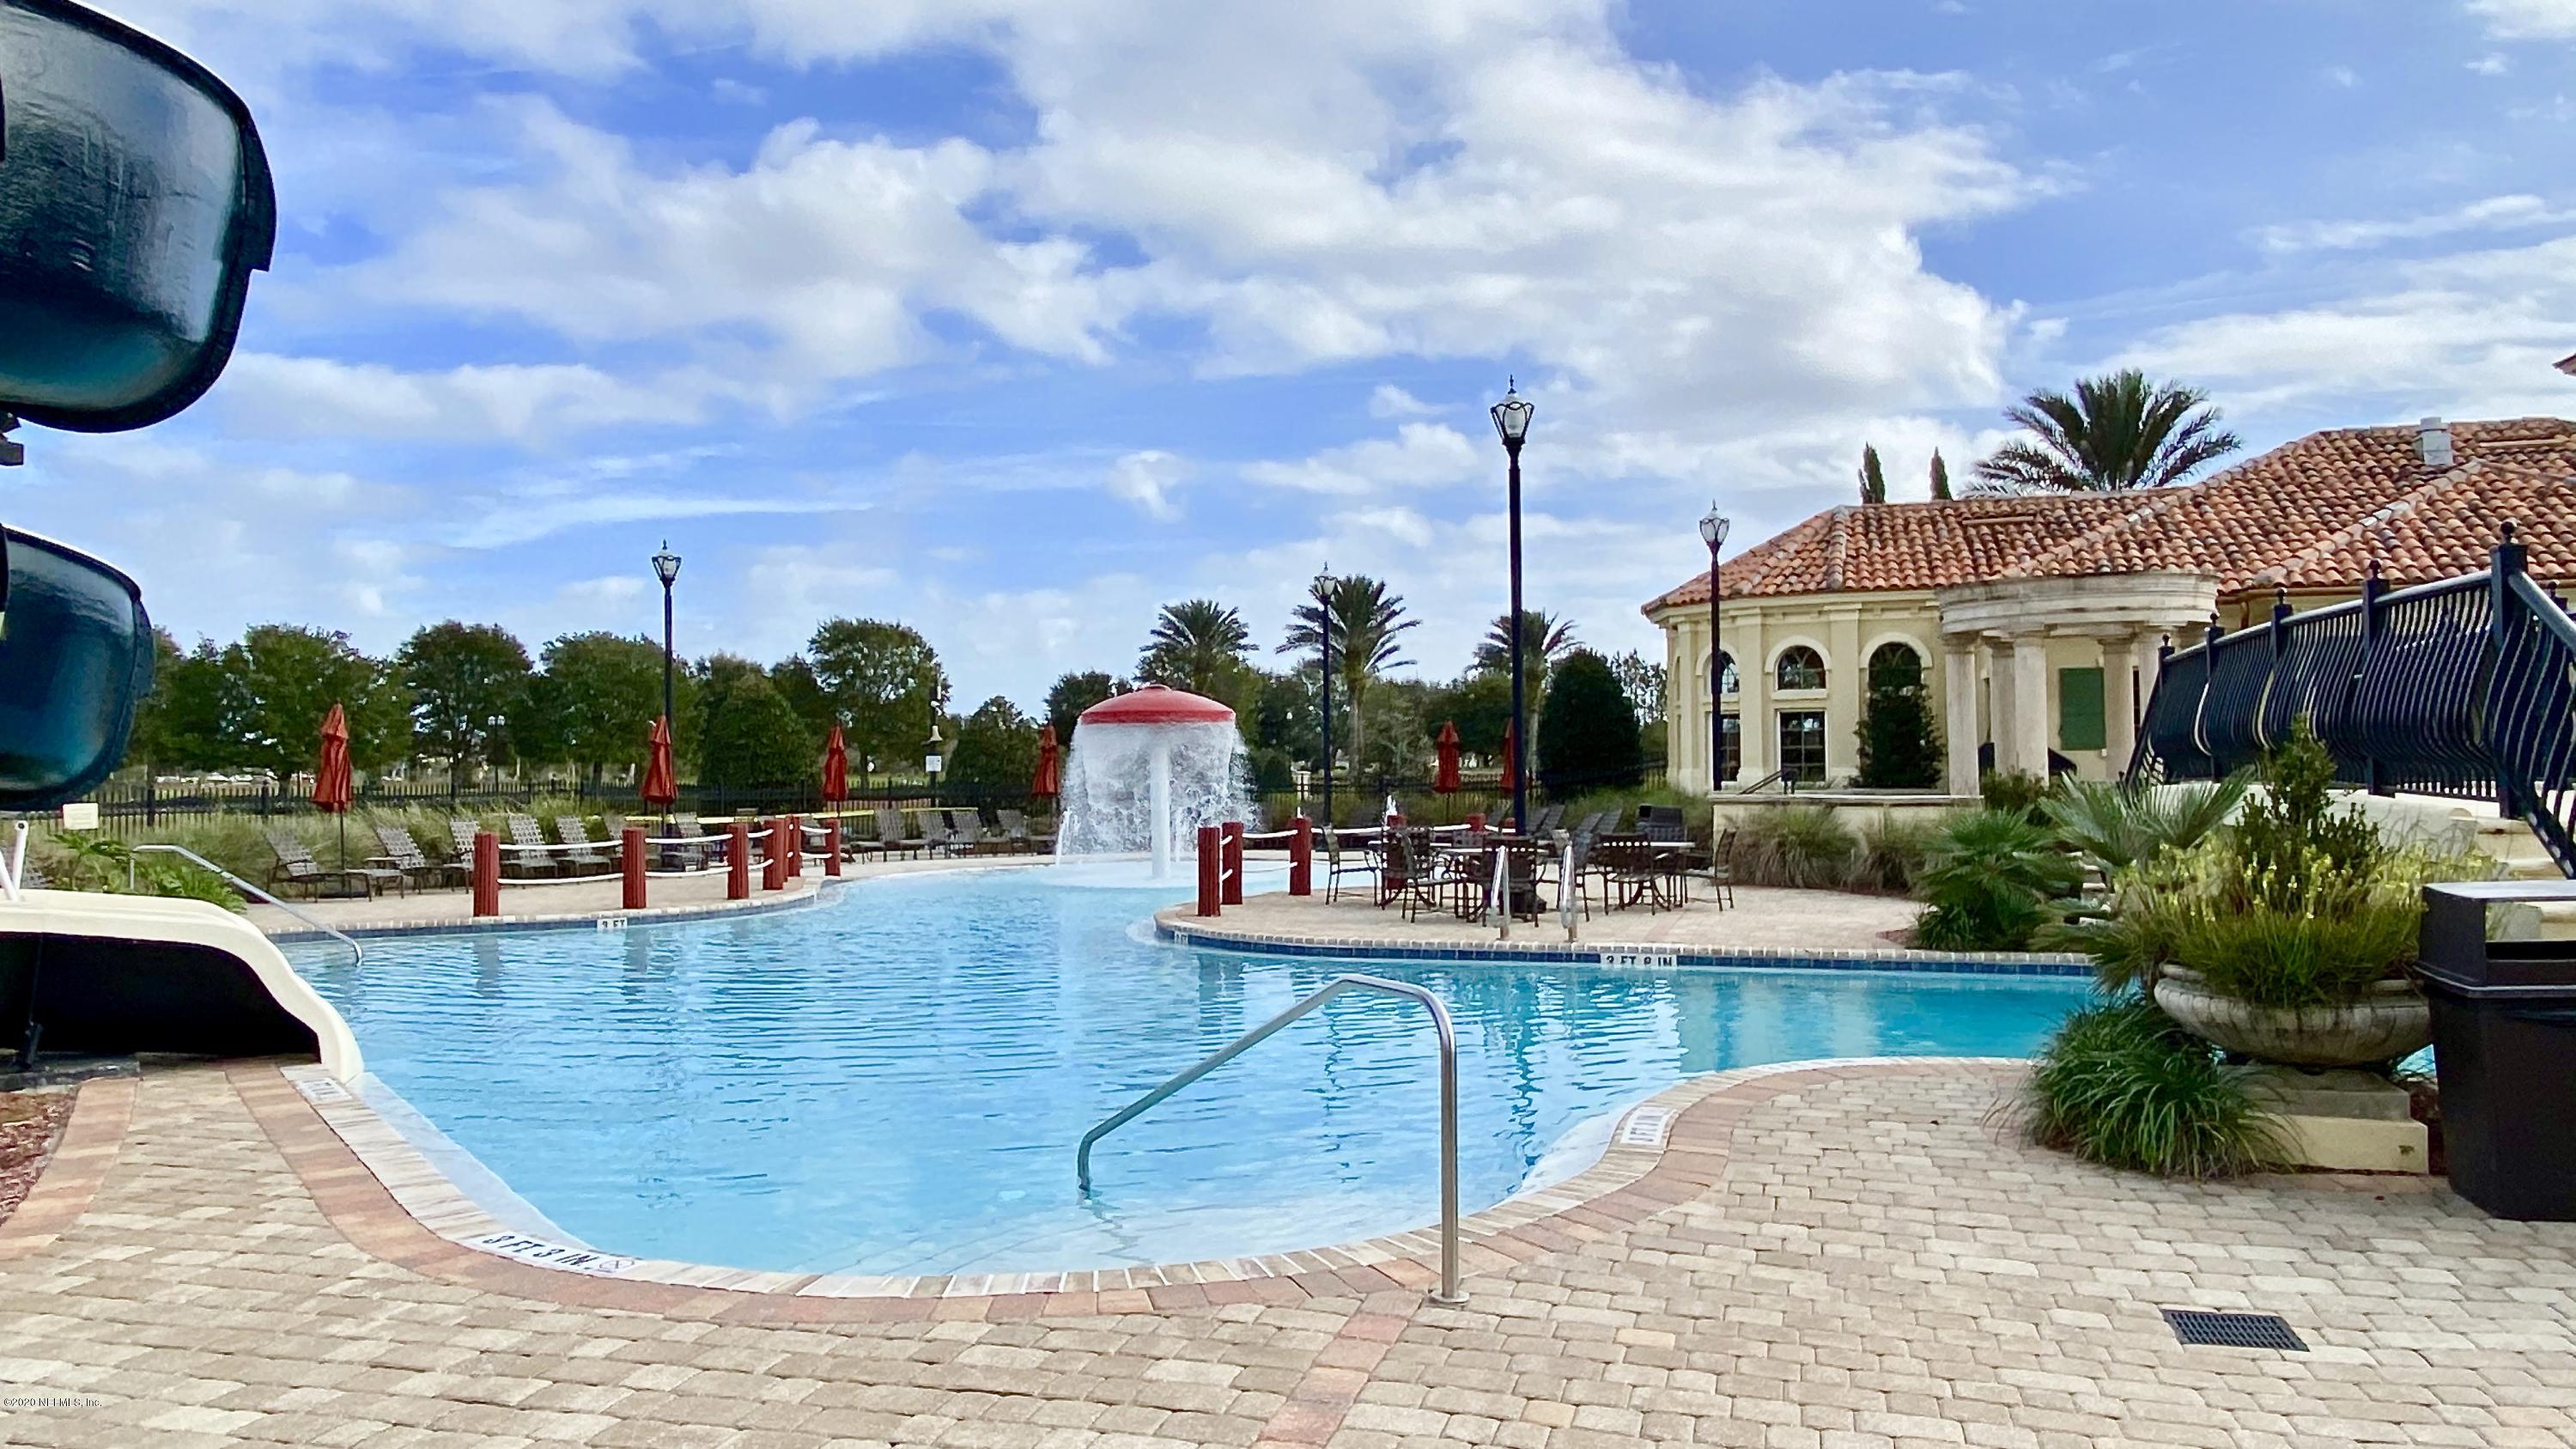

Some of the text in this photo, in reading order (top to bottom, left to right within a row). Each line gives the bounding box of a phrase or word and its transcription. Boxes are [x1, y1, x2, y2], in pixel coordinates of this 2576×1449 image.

[1620, 955, 1637, 965] FT
[1657, 956, 1672, 967] IN
[498, 1240, 545, 1253] FT
